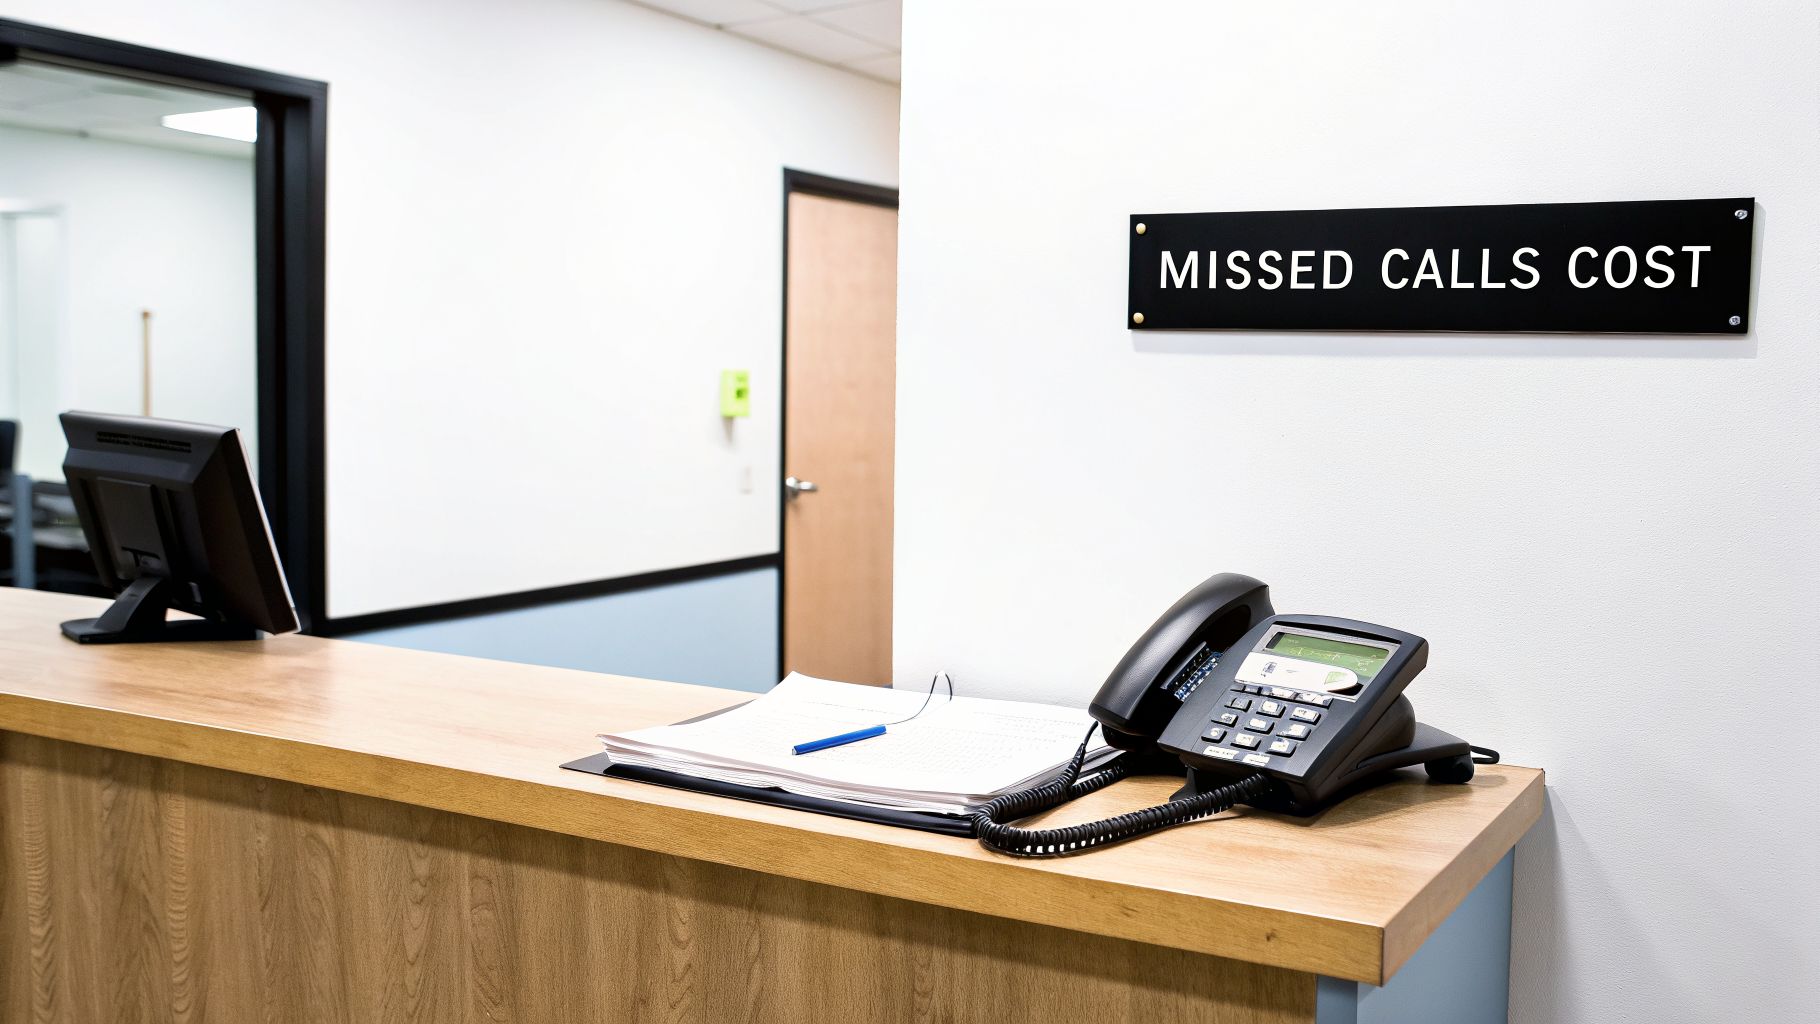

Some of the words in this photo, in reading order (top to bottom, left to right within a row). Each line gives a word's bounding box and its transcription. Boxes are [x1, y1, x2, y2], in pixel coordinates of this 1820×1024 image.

[1160, 249, 1353, 290] MISSED
[1381, 246, 1541, 290] CALLS
[1567, 244, 1712, 289] COST
